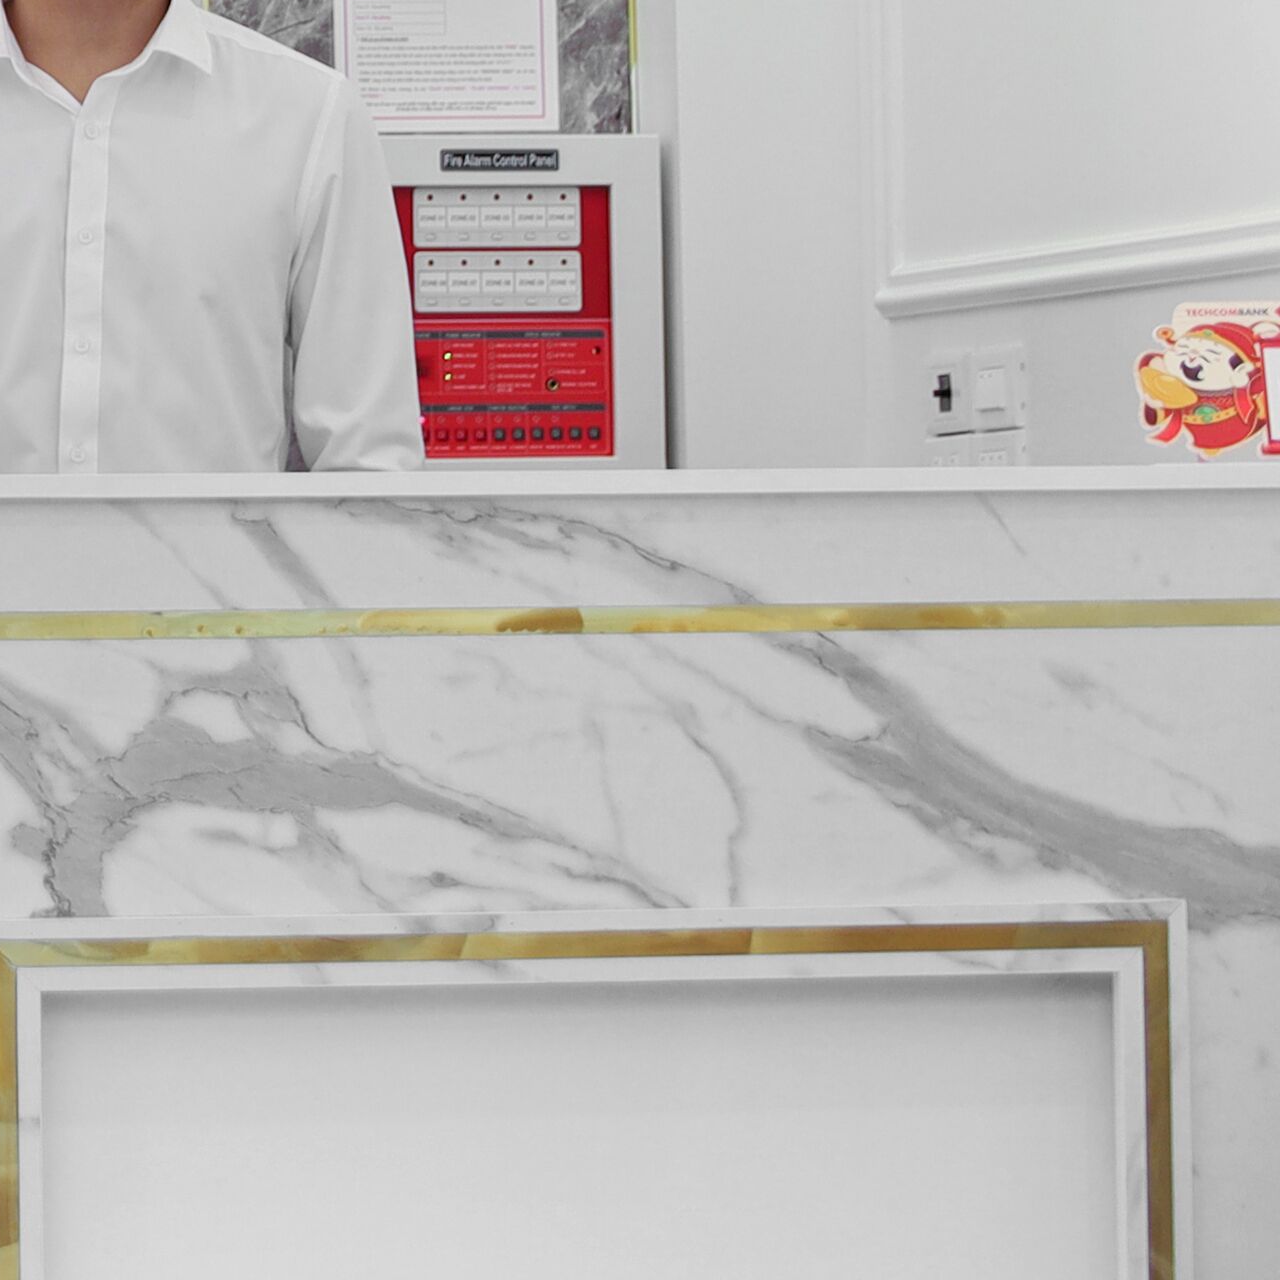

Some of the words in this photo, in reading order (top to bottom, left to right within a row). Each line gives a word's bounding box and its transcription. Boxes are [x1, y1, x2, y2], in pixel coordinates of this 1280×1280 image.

[443, 152, 463, 168] Fire
[464, 152, 491, 167] Alarm
[492, 152, 528, 168] Control
[529, 152, 557, 167] Panel
[1186, 308, 1269, 317] TECHCOMBANK
